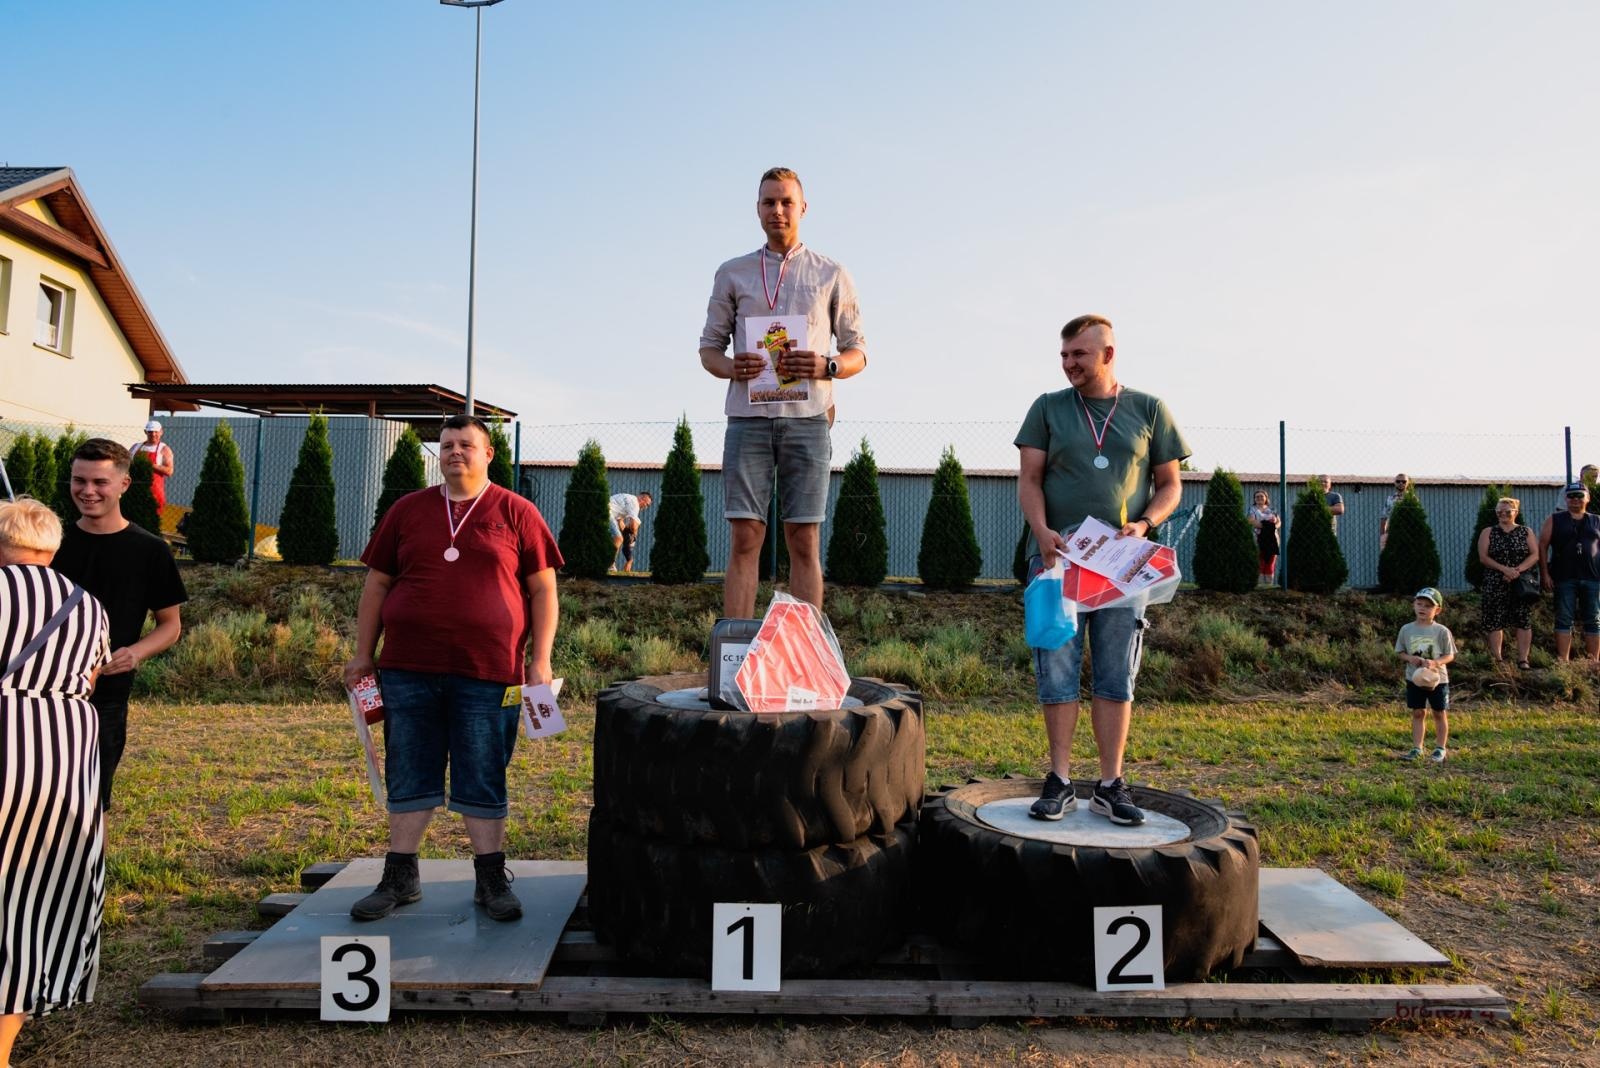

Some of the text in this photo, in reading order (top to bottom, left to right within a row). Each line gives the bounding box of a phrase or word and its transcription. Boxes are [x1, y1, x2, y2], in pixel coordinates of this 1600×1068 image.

[723, 654, 733, 662] CC
[331, 943, 380, 1012] 3
[727, 916, 754, 981] 1
[1106, 915, 1154, 985] 2
